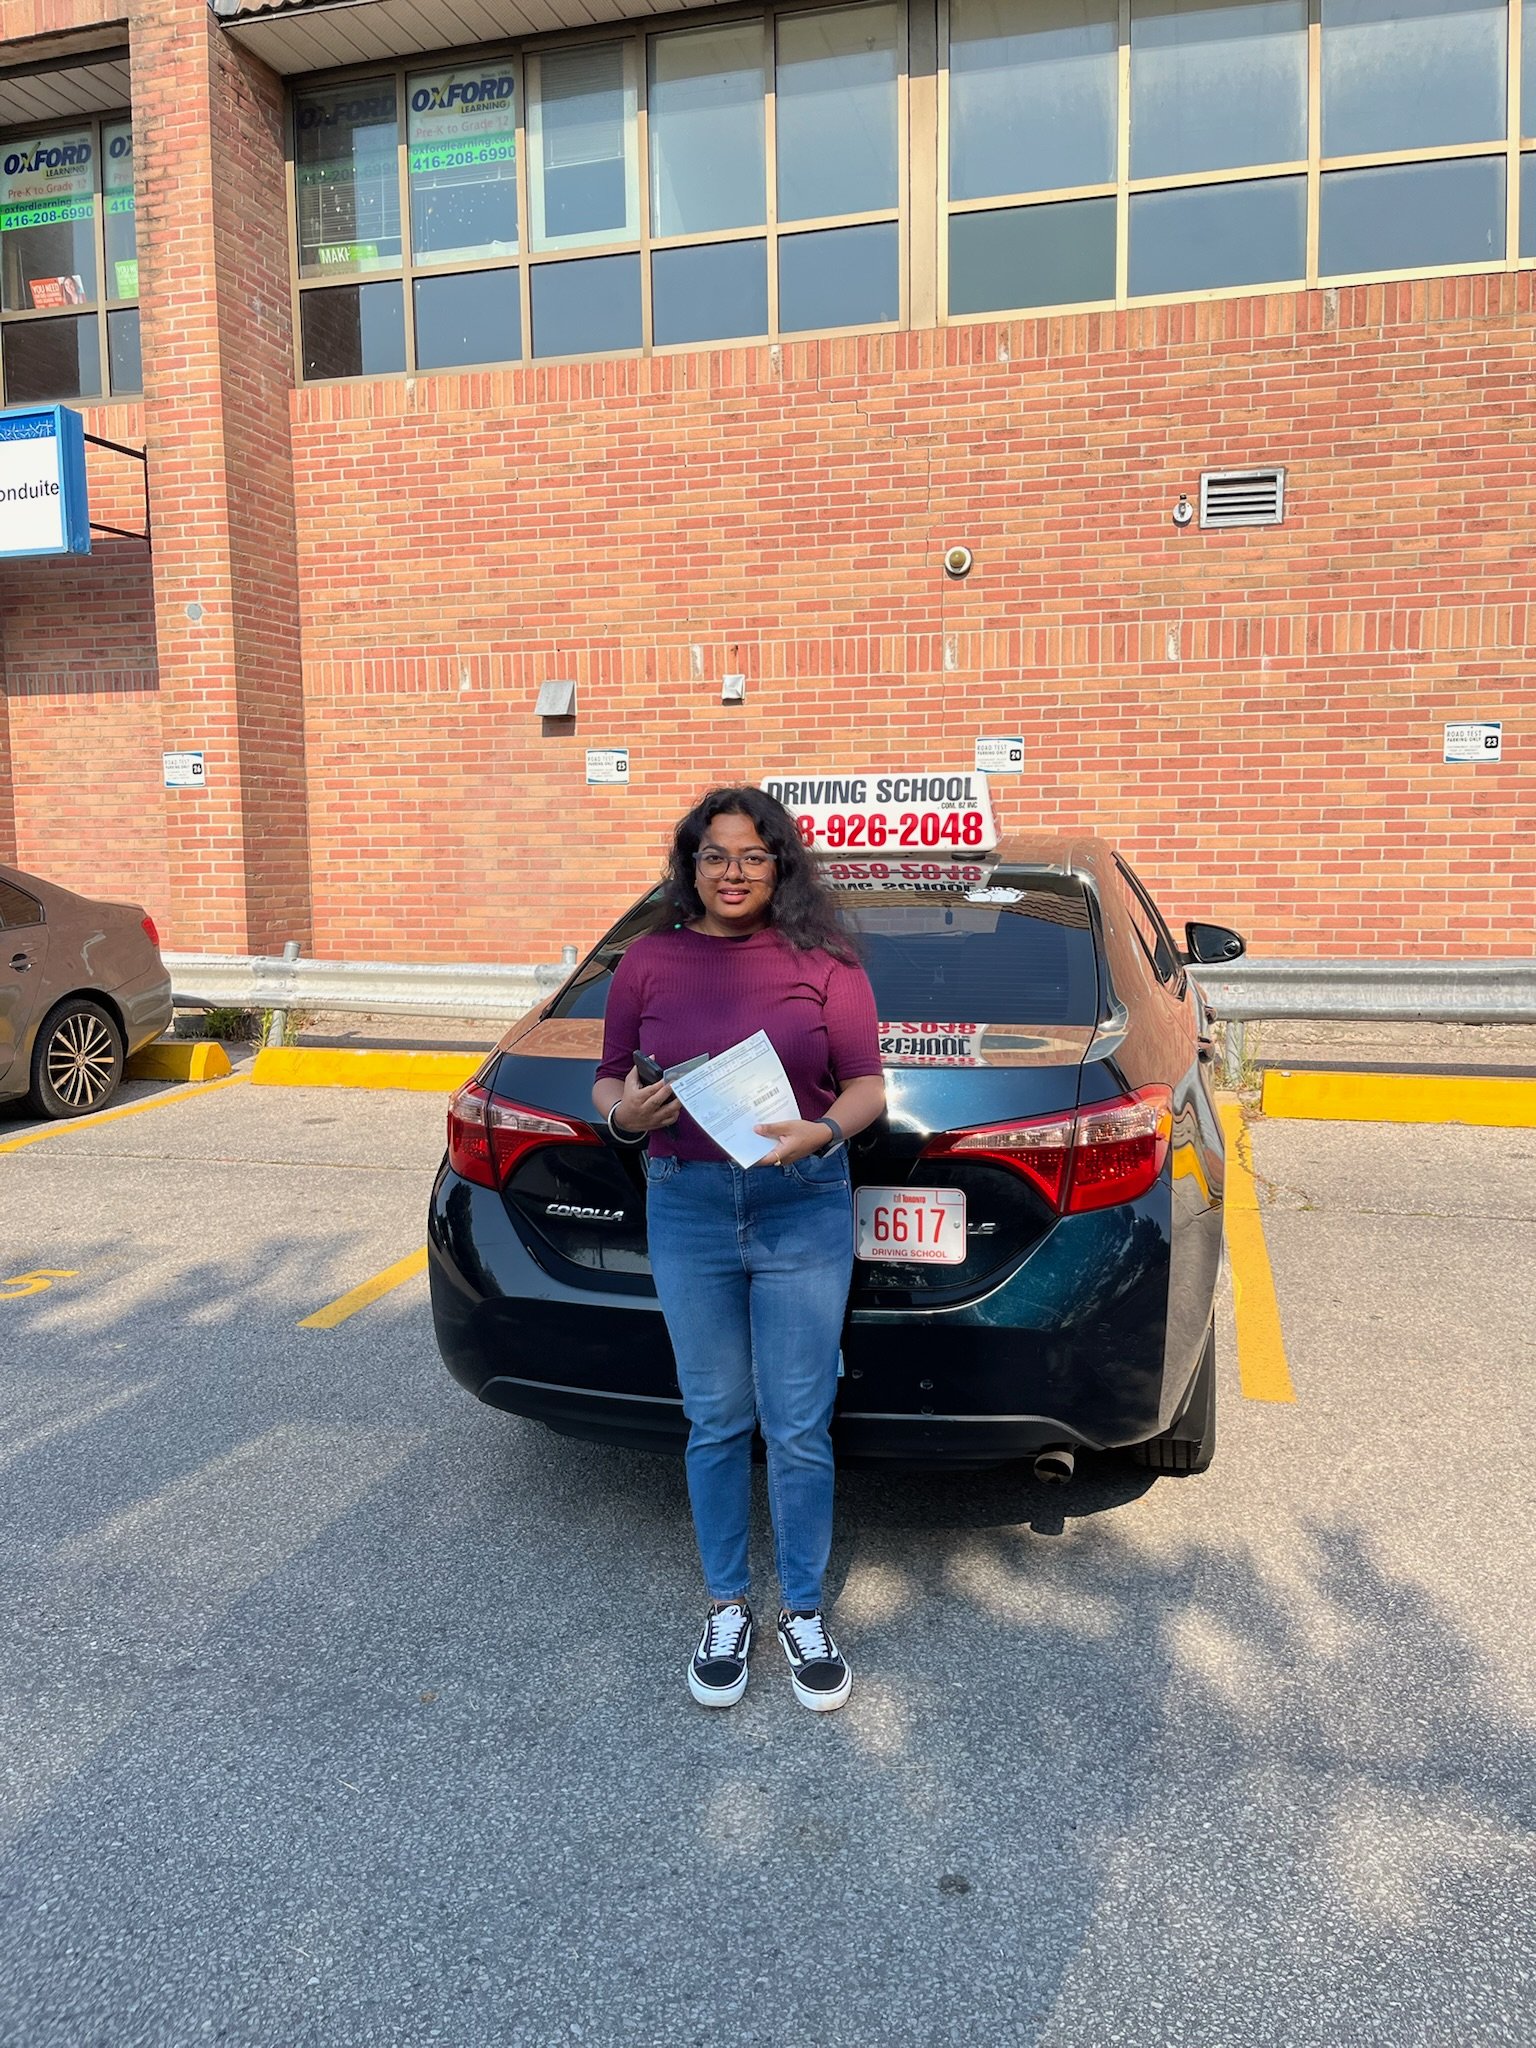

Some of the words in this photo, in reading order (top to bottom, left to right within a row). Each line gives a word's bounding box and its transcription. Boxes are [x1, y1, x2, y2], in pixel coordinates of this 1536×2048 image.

[412, 76, 514, 112] OXFORD
[461, 100, 506, 113] LEARNING
[416, 127, 443, 138] Pre-K
[448, 124, 458, 134] to
[461, 117, 493, 131] Grade
[413, 135, 513, 155] oxfordlearning.com
[4, 142, 91, 175] OXFORD
[413, 145, 515, 170] 416-208-6990
[46, 165, 85, 177] LEARNING
[8, 187, 31, 199] Pre-K
[34, 186, 44, 195] to
[46, 181, 73, 194] Grade
[5, 205, 93, 228] 416-208-6990
[33, 284, 45, 294] YOU
[1486, 737, 1498, 748] 23
[1010, 750, 1020, 760] 24
[767, 779, 866, 804] DRIVING
[876, 777, 977, 803] SCHOOL
[546, 1203, 624, 1221] COROLLA
[874, 1206, 946, 1243] 6617
[872, 1248, 908, 1256] DRIVING
[911, 1249, 948, 1258] SCHOOL
